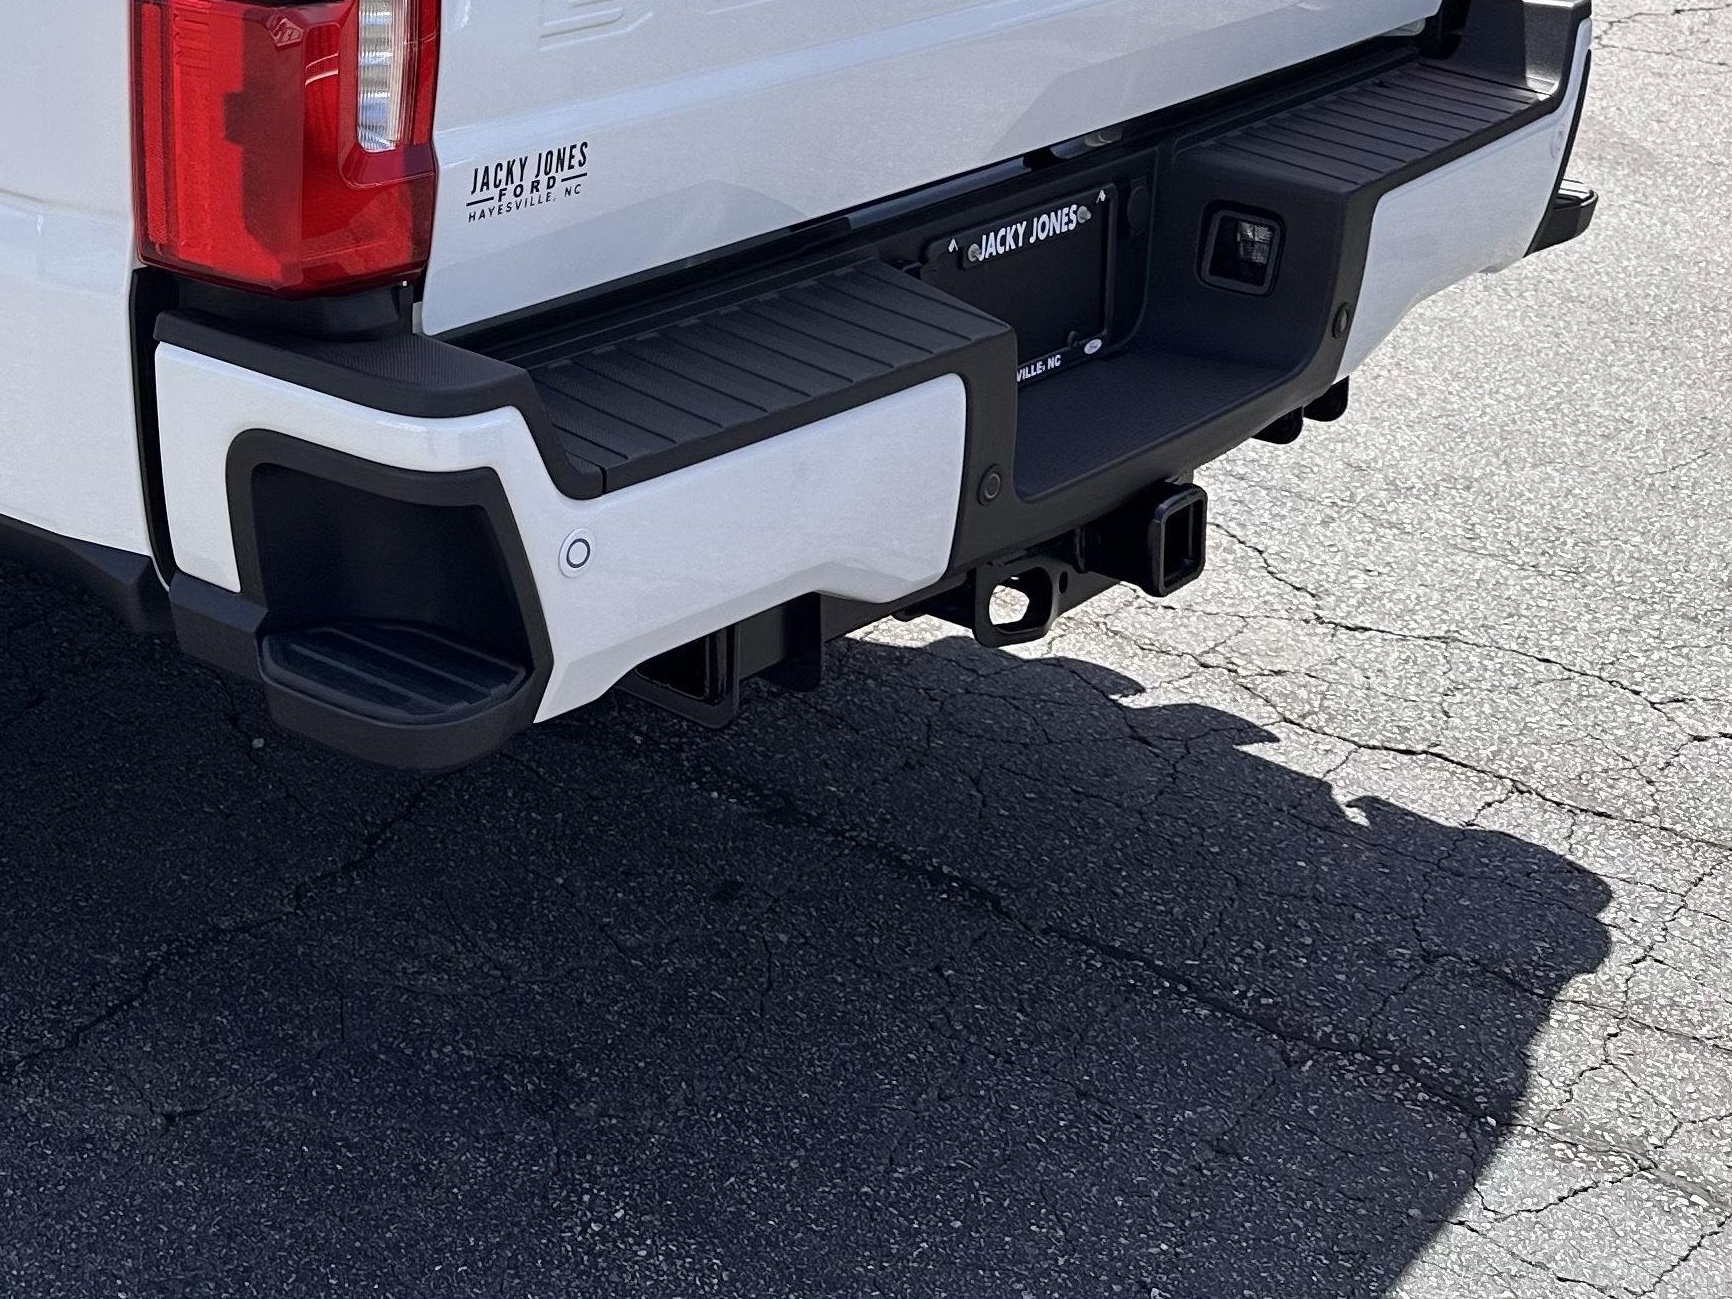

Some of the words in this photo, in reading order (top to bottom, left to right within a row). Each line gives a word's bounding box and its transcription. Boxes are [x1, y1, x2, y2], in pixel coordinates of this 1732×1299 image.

[471, 155, 528, 195] JACKY
[535, 141, 588, 179] JONES
[468, 191, 557, 223] HAYESVILLE,
[564, 183, 582, 198] NC
[497, 175, 557, 203] FORD
[979, 220, 1027, 261] JACKY
[1029, 204, 1078, 244] JONES
[1048, 354, 1062, 370] NC
